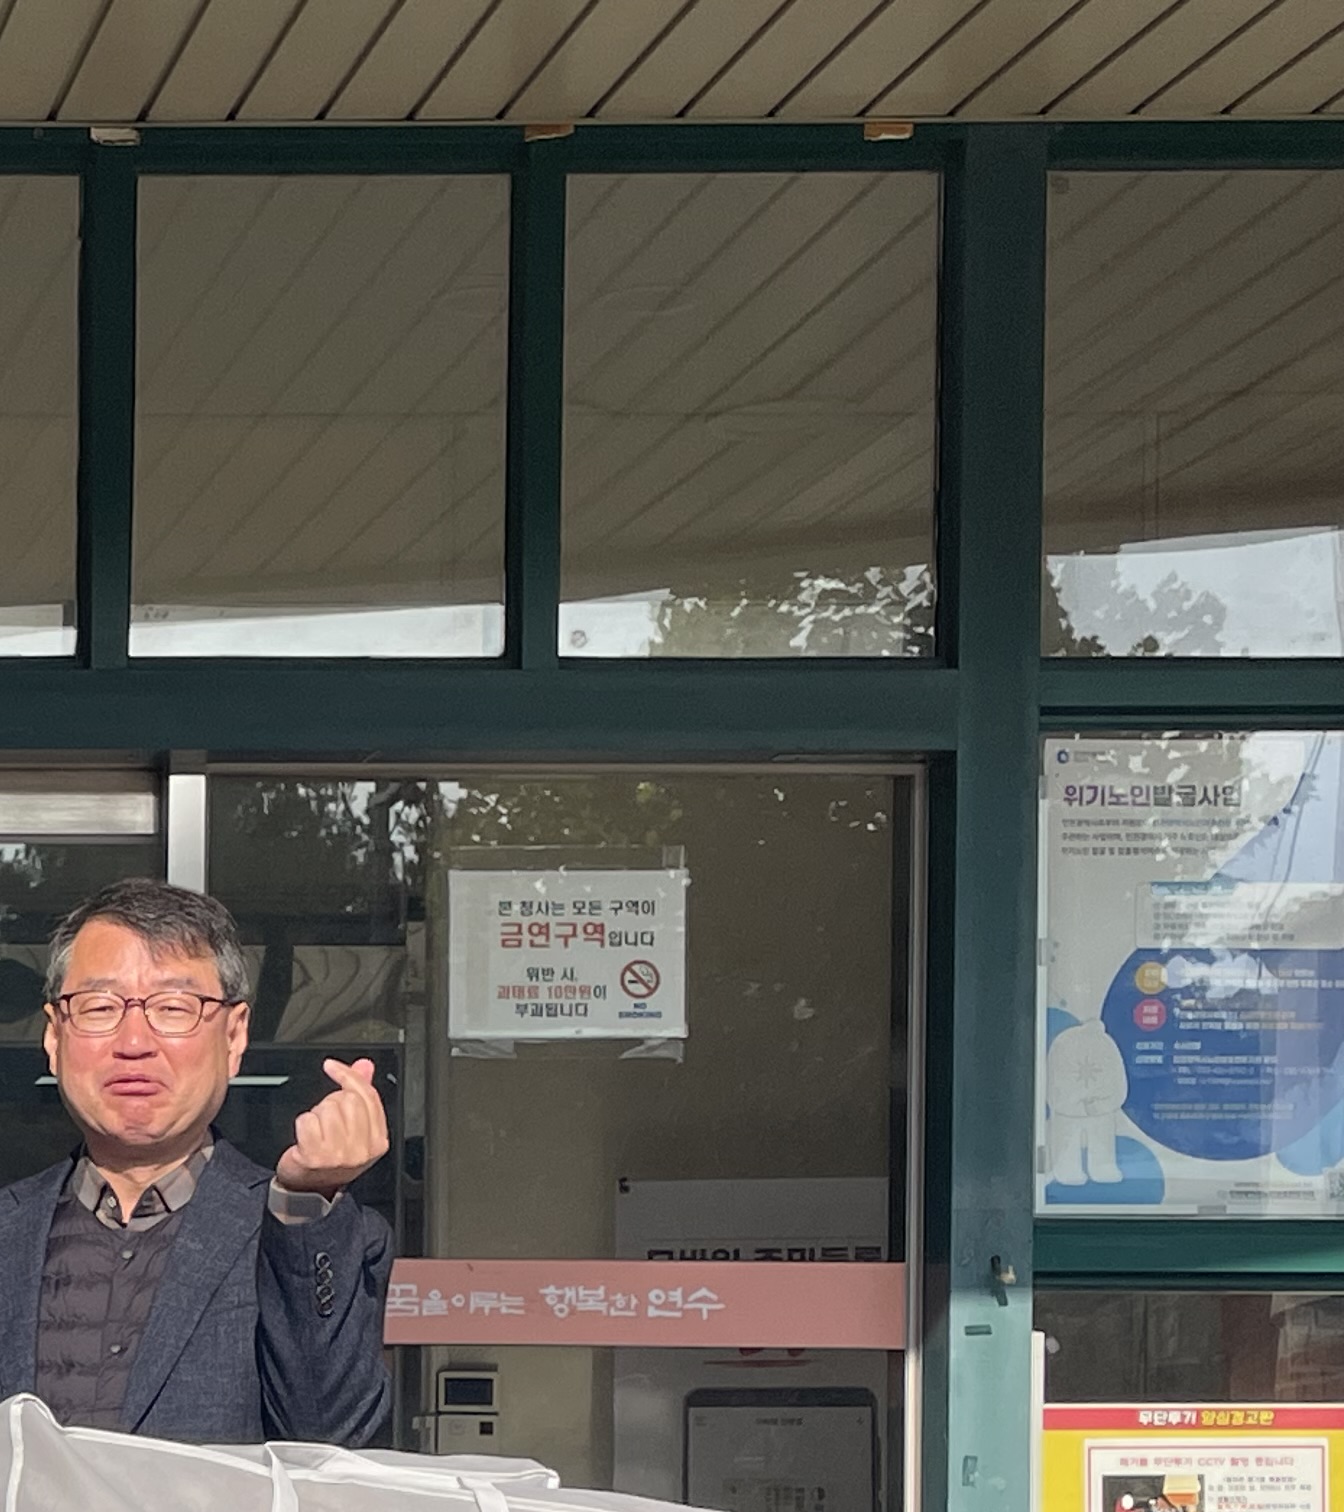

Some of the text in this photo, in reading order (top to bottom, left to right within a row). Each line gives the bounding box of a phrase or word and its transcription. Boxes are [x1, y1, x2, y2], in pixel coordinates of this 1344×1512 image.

[498, 900, 655, 917] 본 청사는 모든 구역이
[526, 966, 555, 983] 위반
[497, 984, 607, 1001] 과태료 10만원이
[514, 1002, 589, 1018] 부과됩니다
[633, 1002, 648, 1010] NO
[540, 1283, 727, 1321] 행복한 연수
[1138, 1410, 1275, 1427] 무단투기 양심경고판
[1197, 1457, 1226, 1467] CCTV
